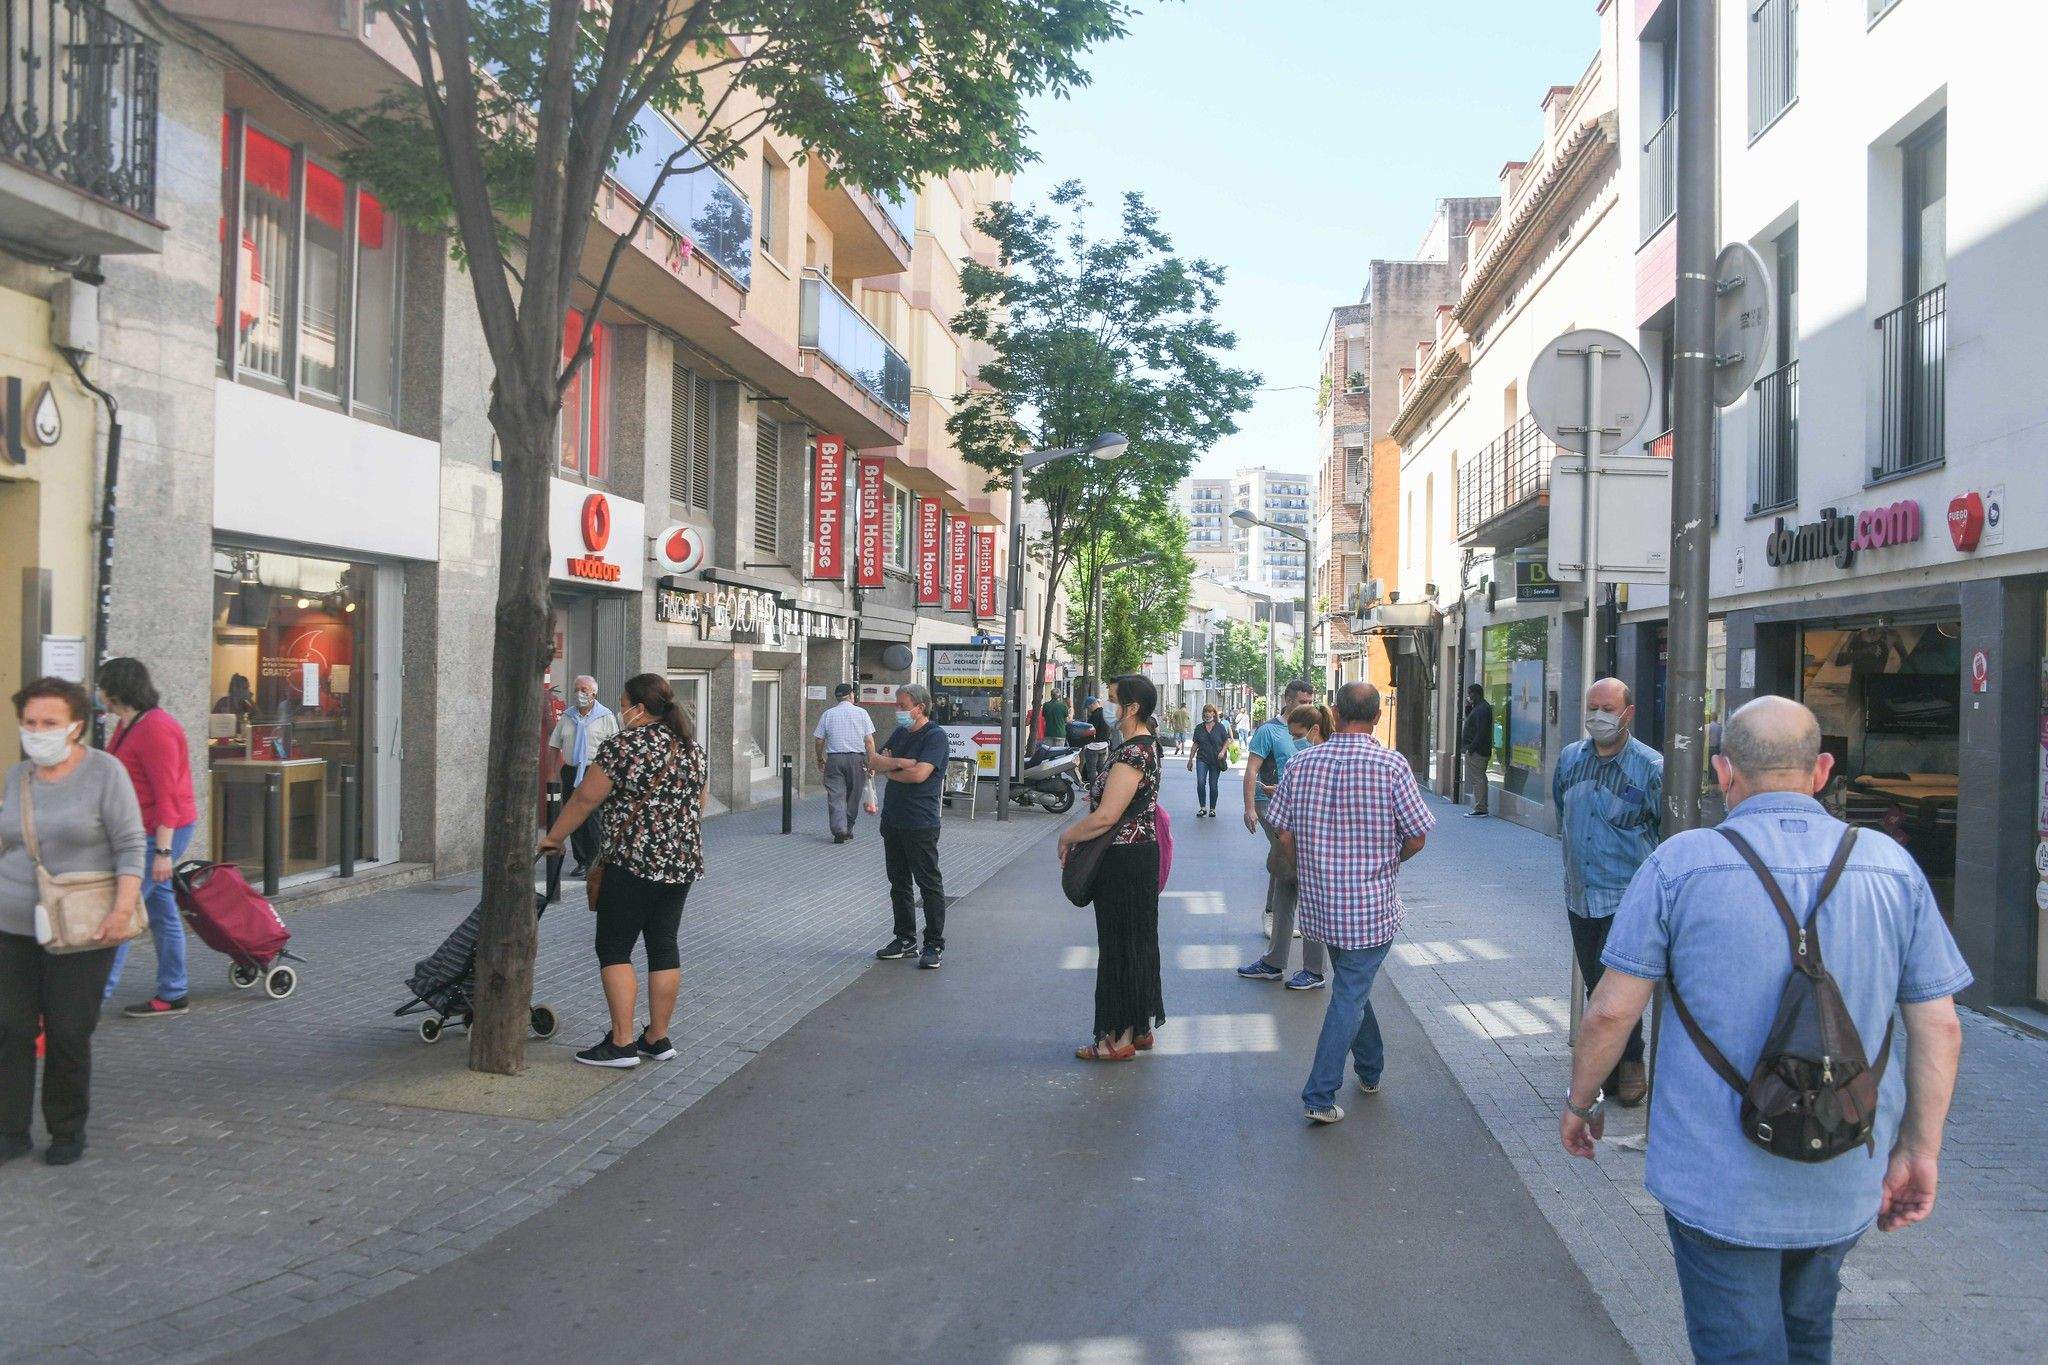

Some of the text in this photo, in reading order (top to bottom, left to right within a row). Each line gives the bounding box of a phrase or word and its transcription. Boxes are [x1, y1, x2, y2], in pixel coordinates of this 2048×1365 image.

[818, 442, 838, 568] British House
[863, 465, 880, 577] British House
[1766, 500, 1920, 569] dormity.com
[1948, 509, 1968, 521] FUEGO
[923, 503, 937, 596] British House
[953, 520, 967, 603] British House
[980, 536, 992, 611] British House
[943, 677, 985, 685] COMPREM
